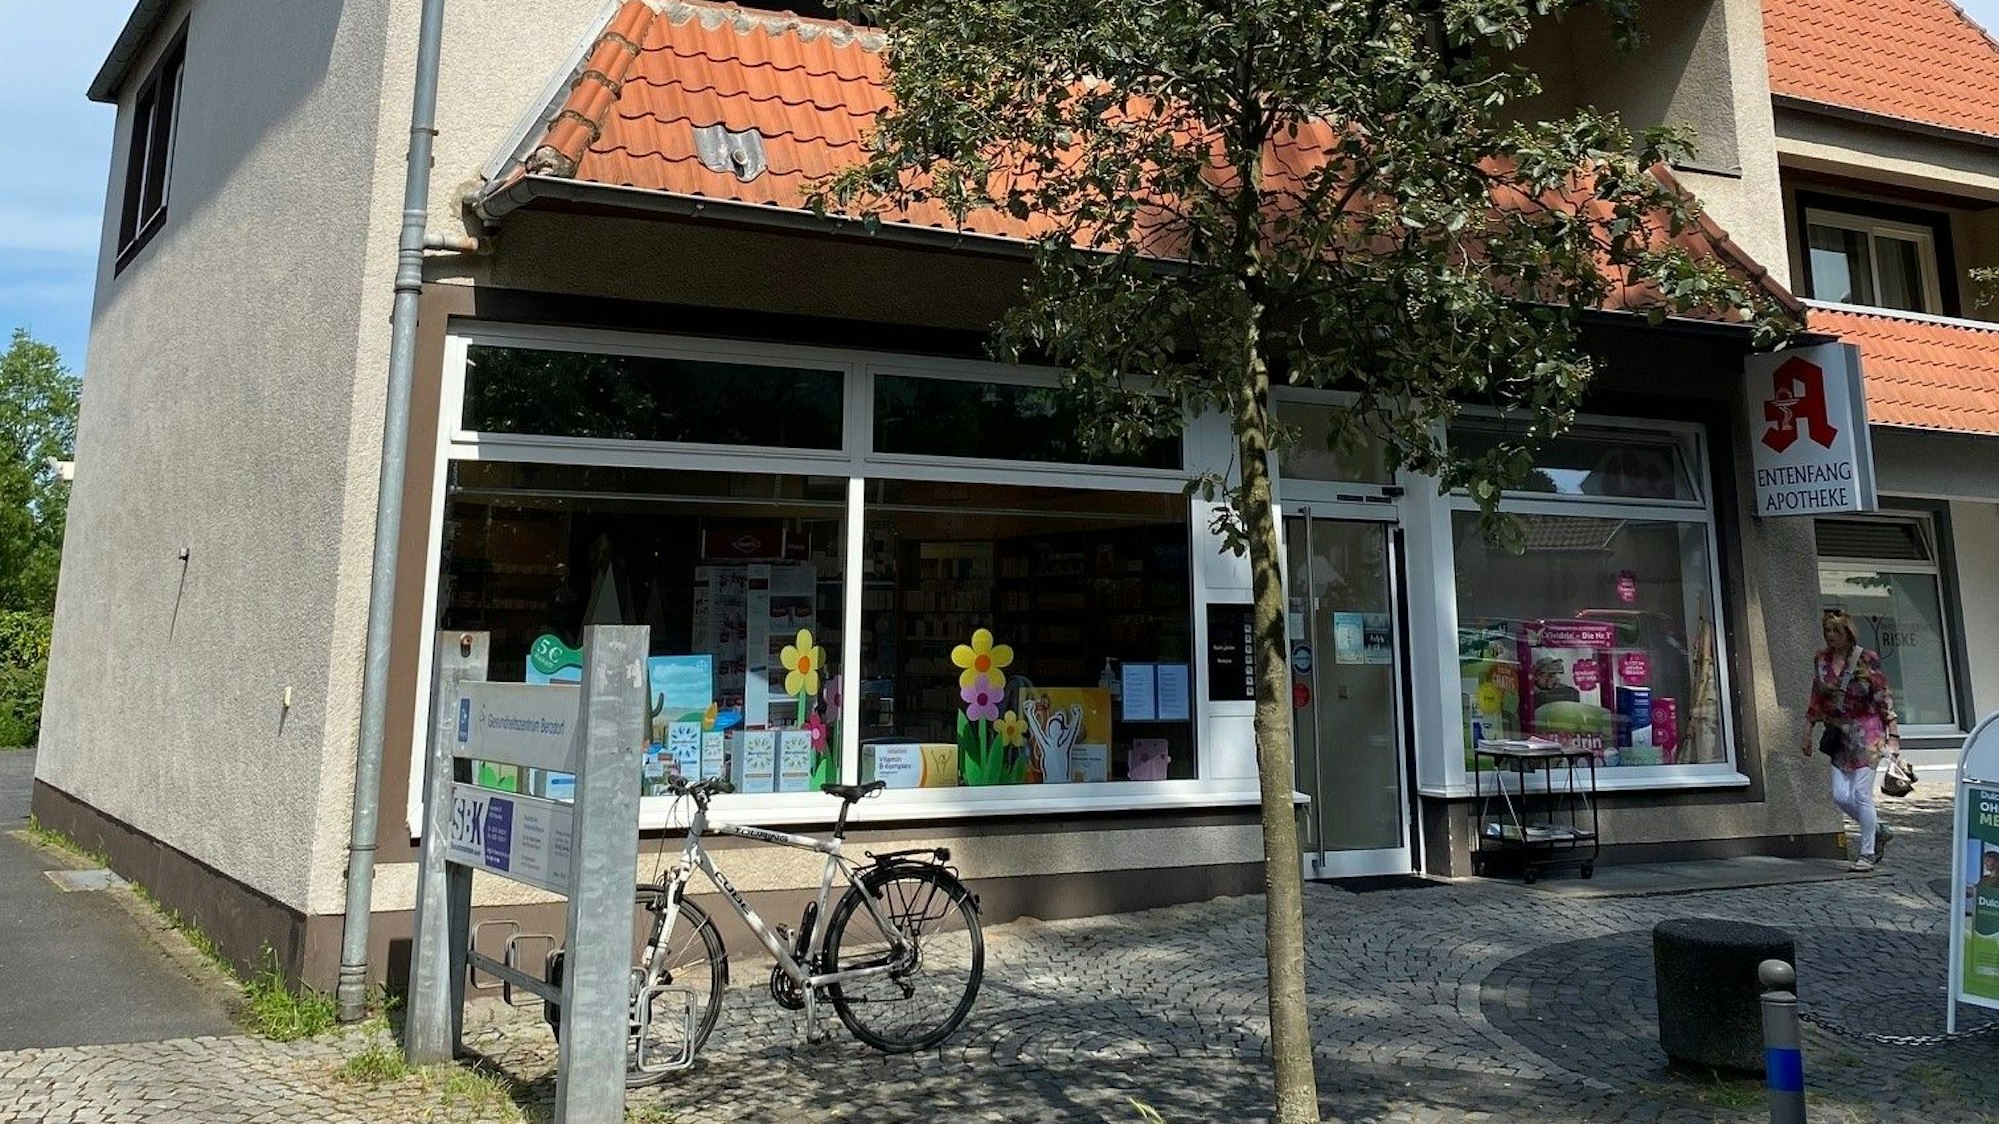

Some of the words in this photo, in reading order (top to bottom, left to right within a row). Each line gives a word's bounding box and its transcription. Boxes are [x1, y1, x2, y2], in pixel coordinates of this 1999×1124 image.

[1757, 461, 1851, 487] ENTENFANG
[1766, 487, 1849, 511] APOTHEKE
[452, 797, 484, 846] SBK
[735, 827, 789, 843] TOURING
